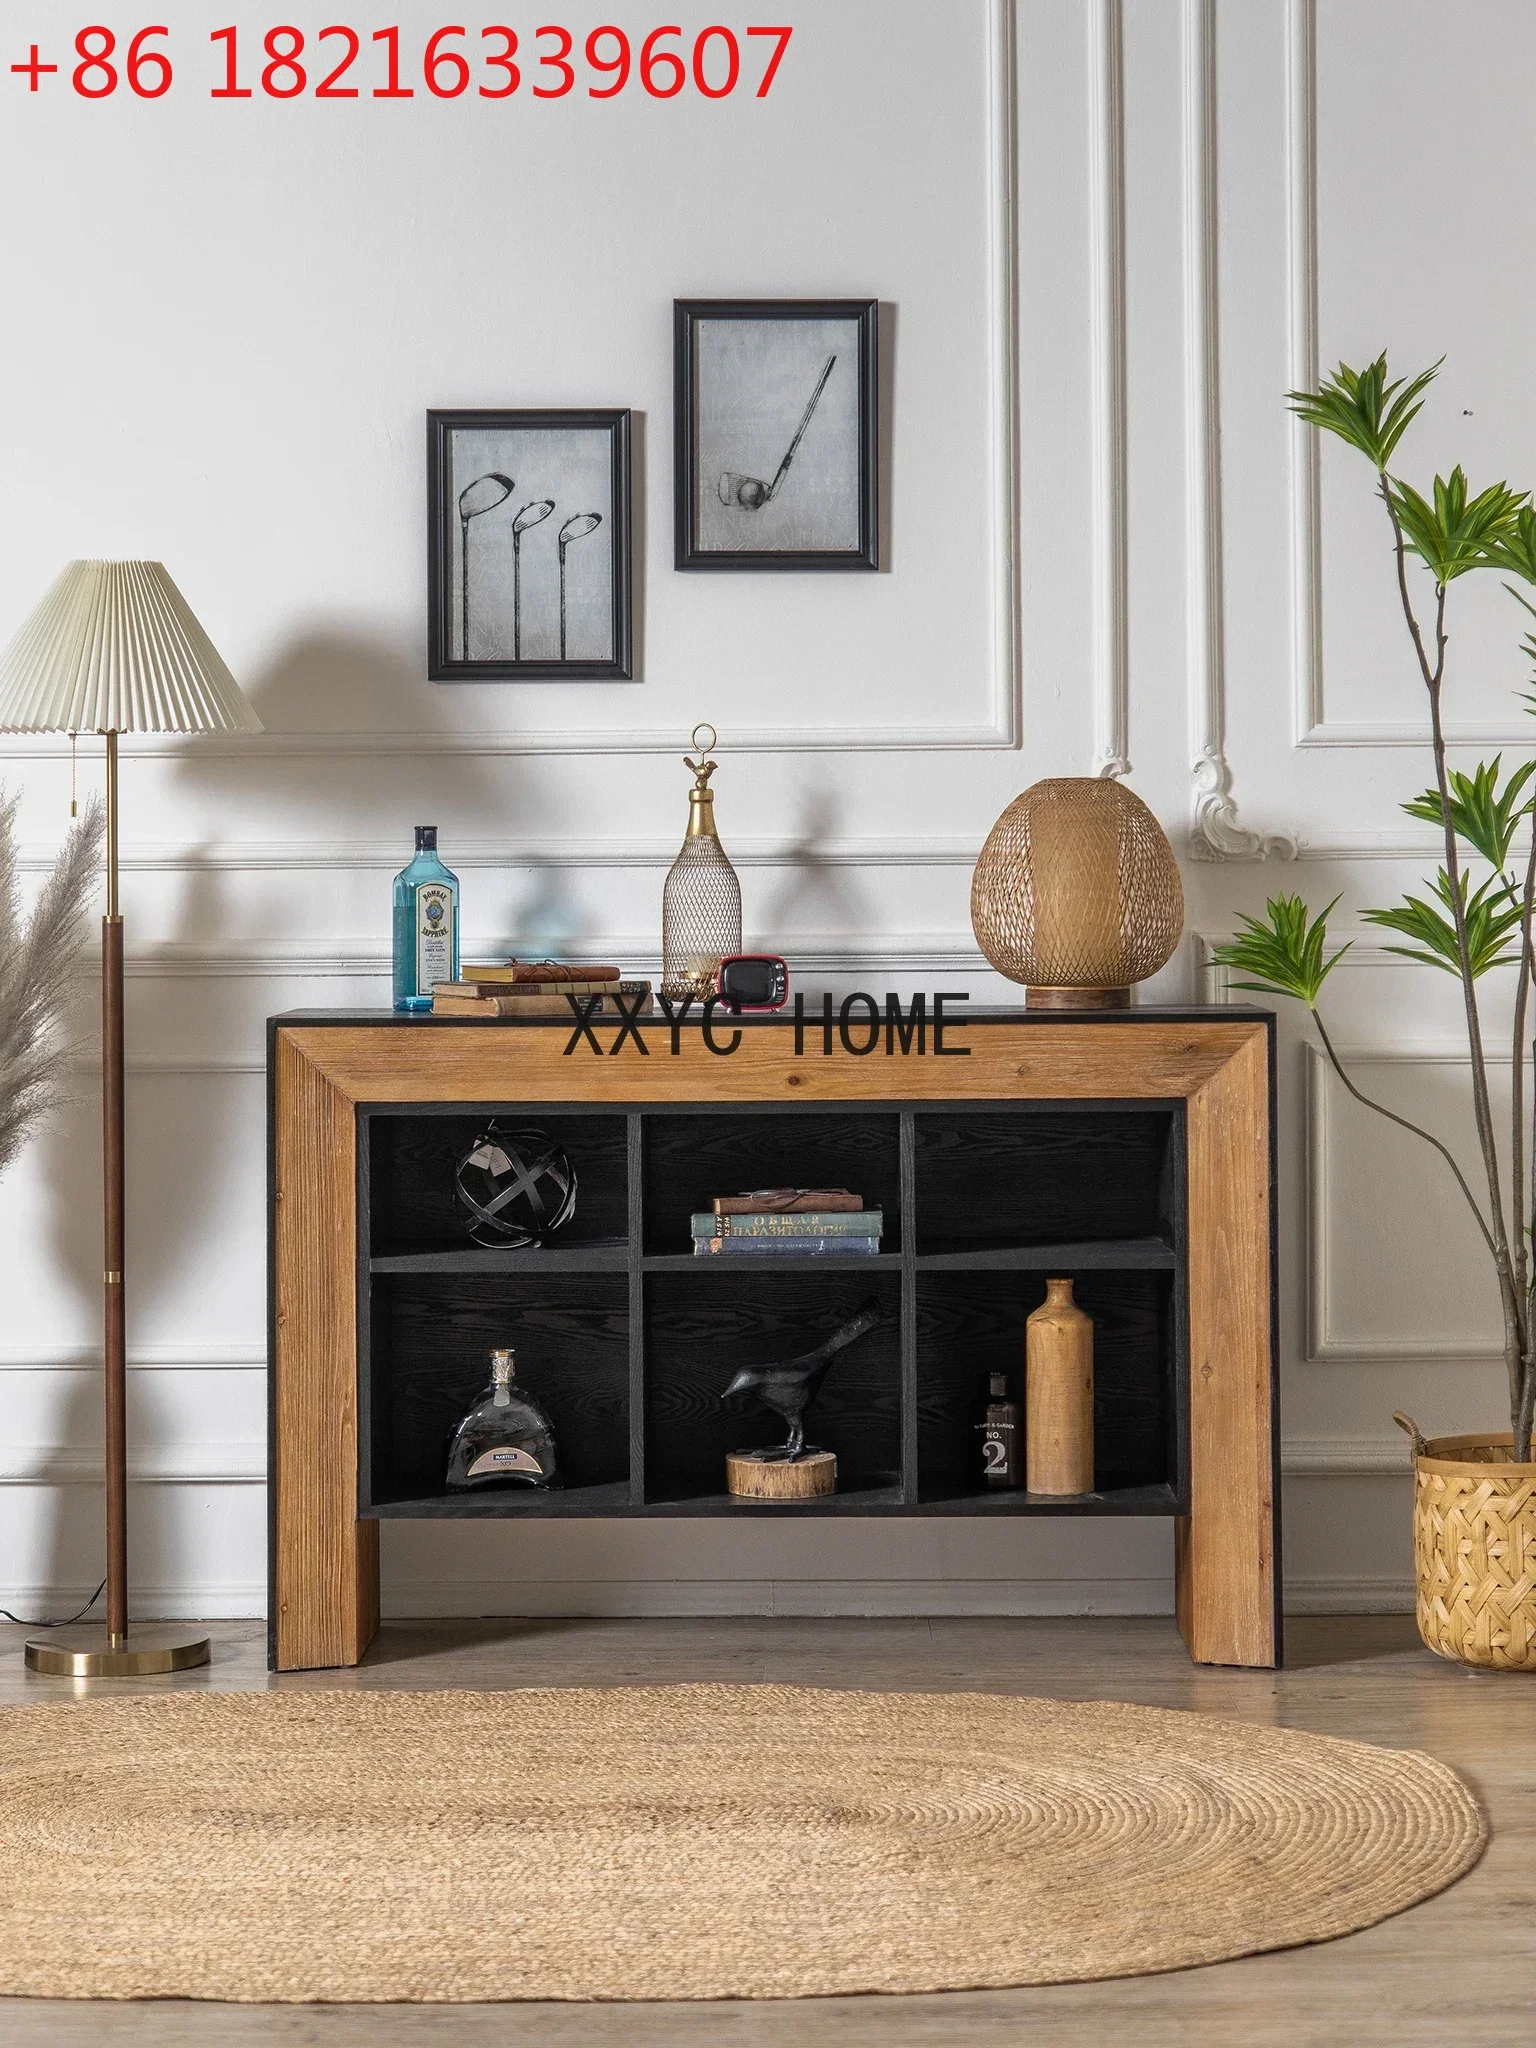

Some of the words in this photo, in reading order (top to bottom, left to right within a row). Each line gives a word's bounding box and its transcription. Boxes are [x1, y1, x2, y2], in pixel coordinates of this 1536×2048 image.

[422, 890, 447, 902] BOMBAY
[421, 926, 449, 938] SAPPHIRE
[753, 1215, 820, 1226] ОБЩАЯ
[986, 1431, 1002, 1439] NO.
[982, 1441, 1008, 1474] 2
